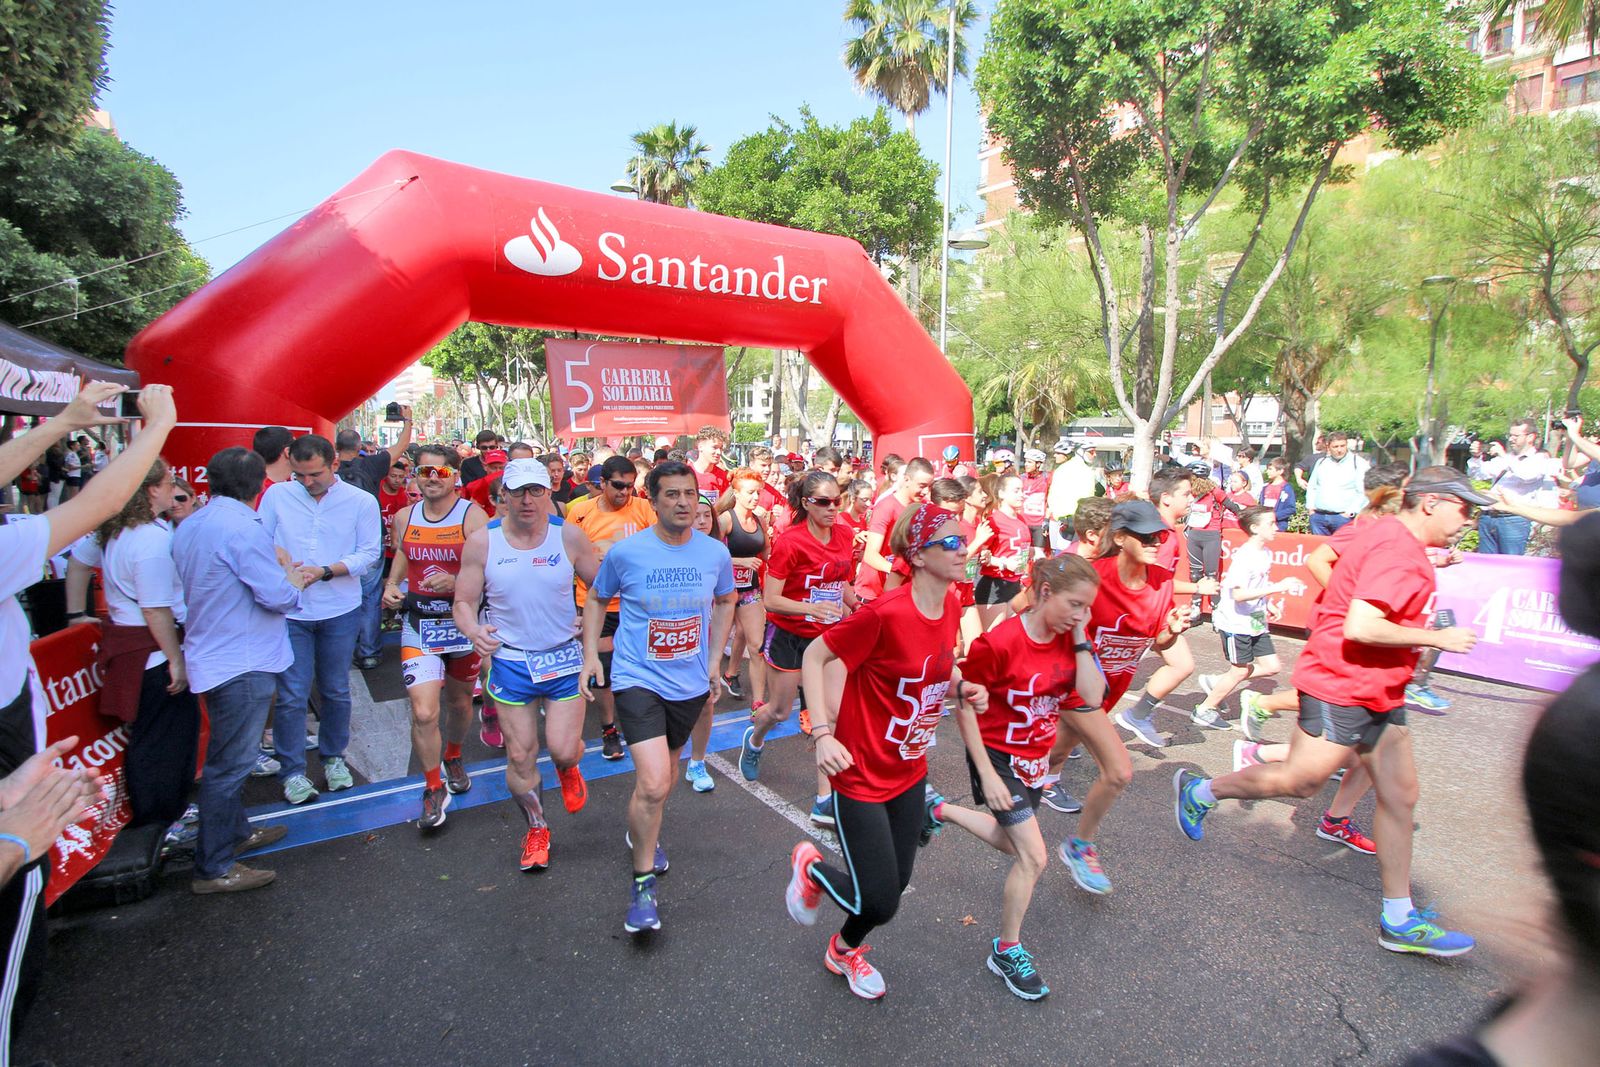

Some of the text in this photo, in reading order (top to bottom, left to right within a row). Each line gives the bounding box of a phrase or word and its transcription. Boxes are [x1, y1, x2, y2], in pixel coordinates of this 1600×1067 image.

[597, 231, 828, 305] Santander
[600, 367, 672, 387] CARRERA
[602, 386, 673, 402] SOLIDARIA
[408, 546, 458, 562] JUANMA
[1471, 586, 1509, 646] 4
[653, 627, 697, 647] 2655
[532, 647, 578, 670] 2032
